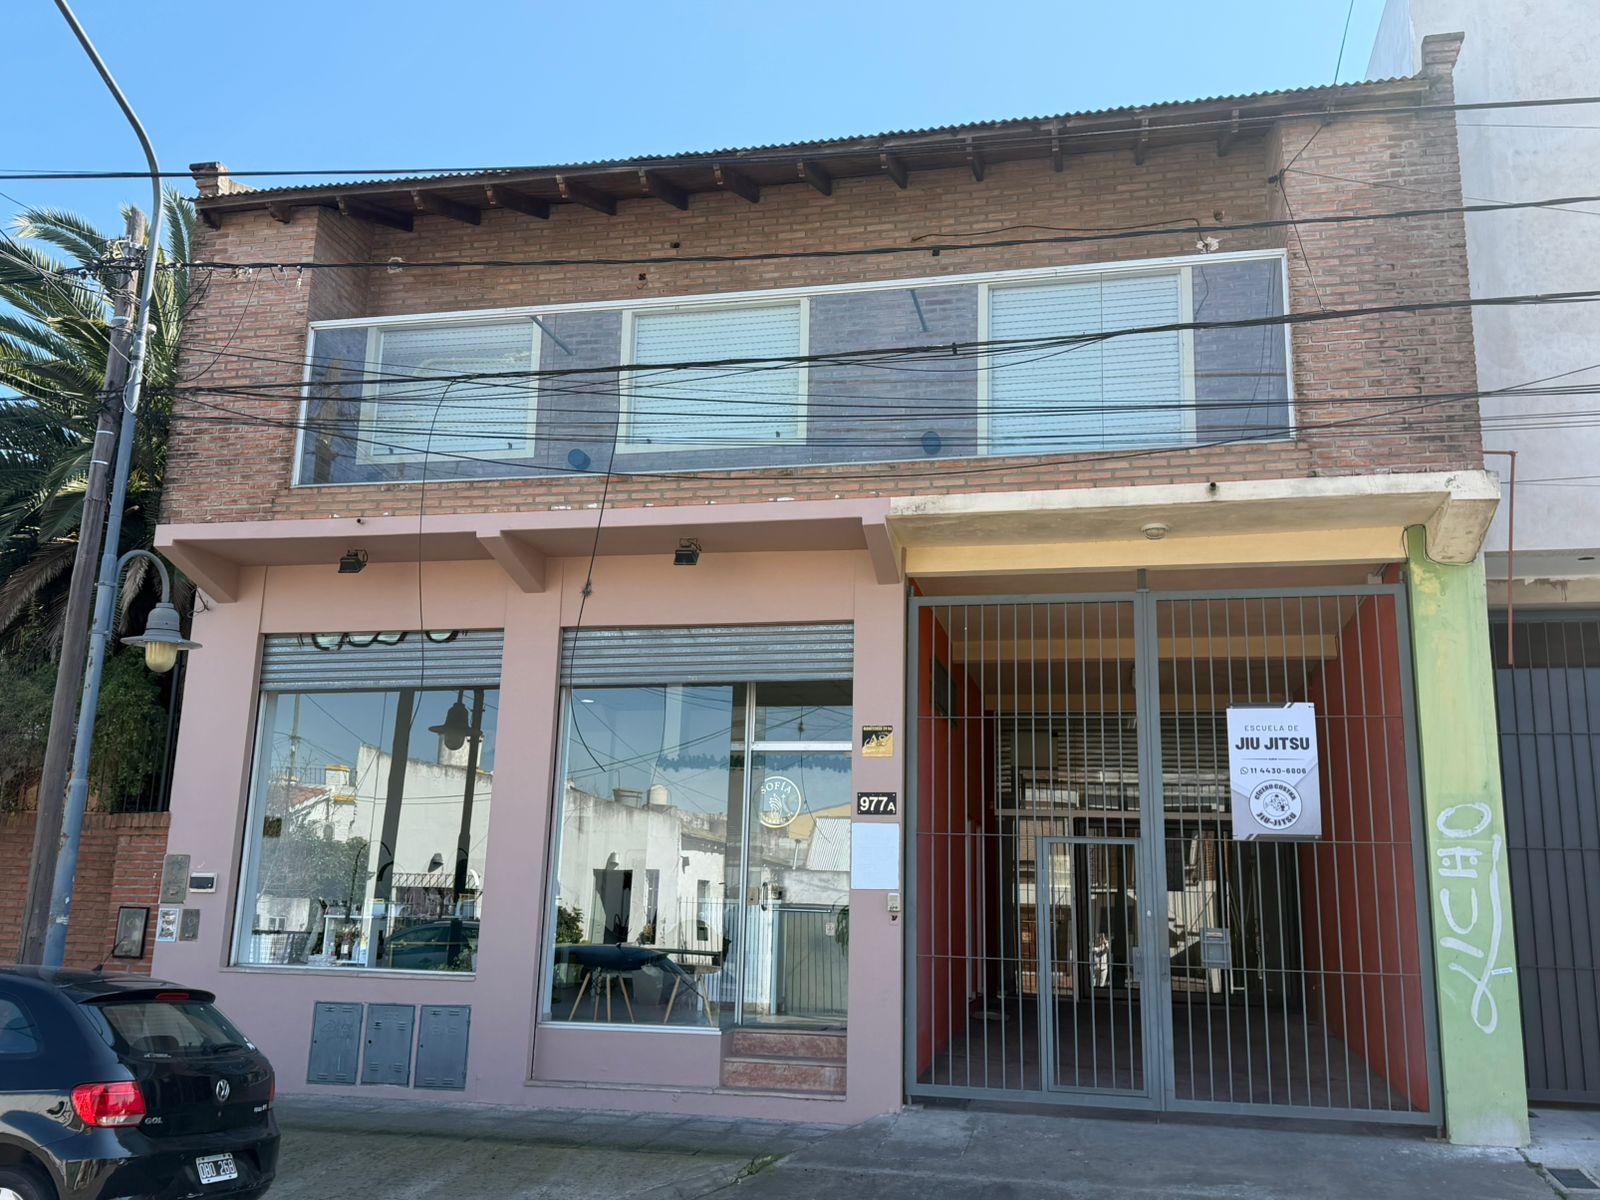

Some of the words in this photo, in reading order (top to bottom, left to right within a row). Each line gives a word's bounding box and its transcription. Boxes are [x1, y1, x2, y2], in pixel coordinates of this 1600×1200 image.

[1235, 737, 1260, 750] JIU
[1264, 737, 1310, 750] JITSU
[1256, 811, 1297, 826] JIU-JITSU
[144, 1116, 164, 1125] GOL
